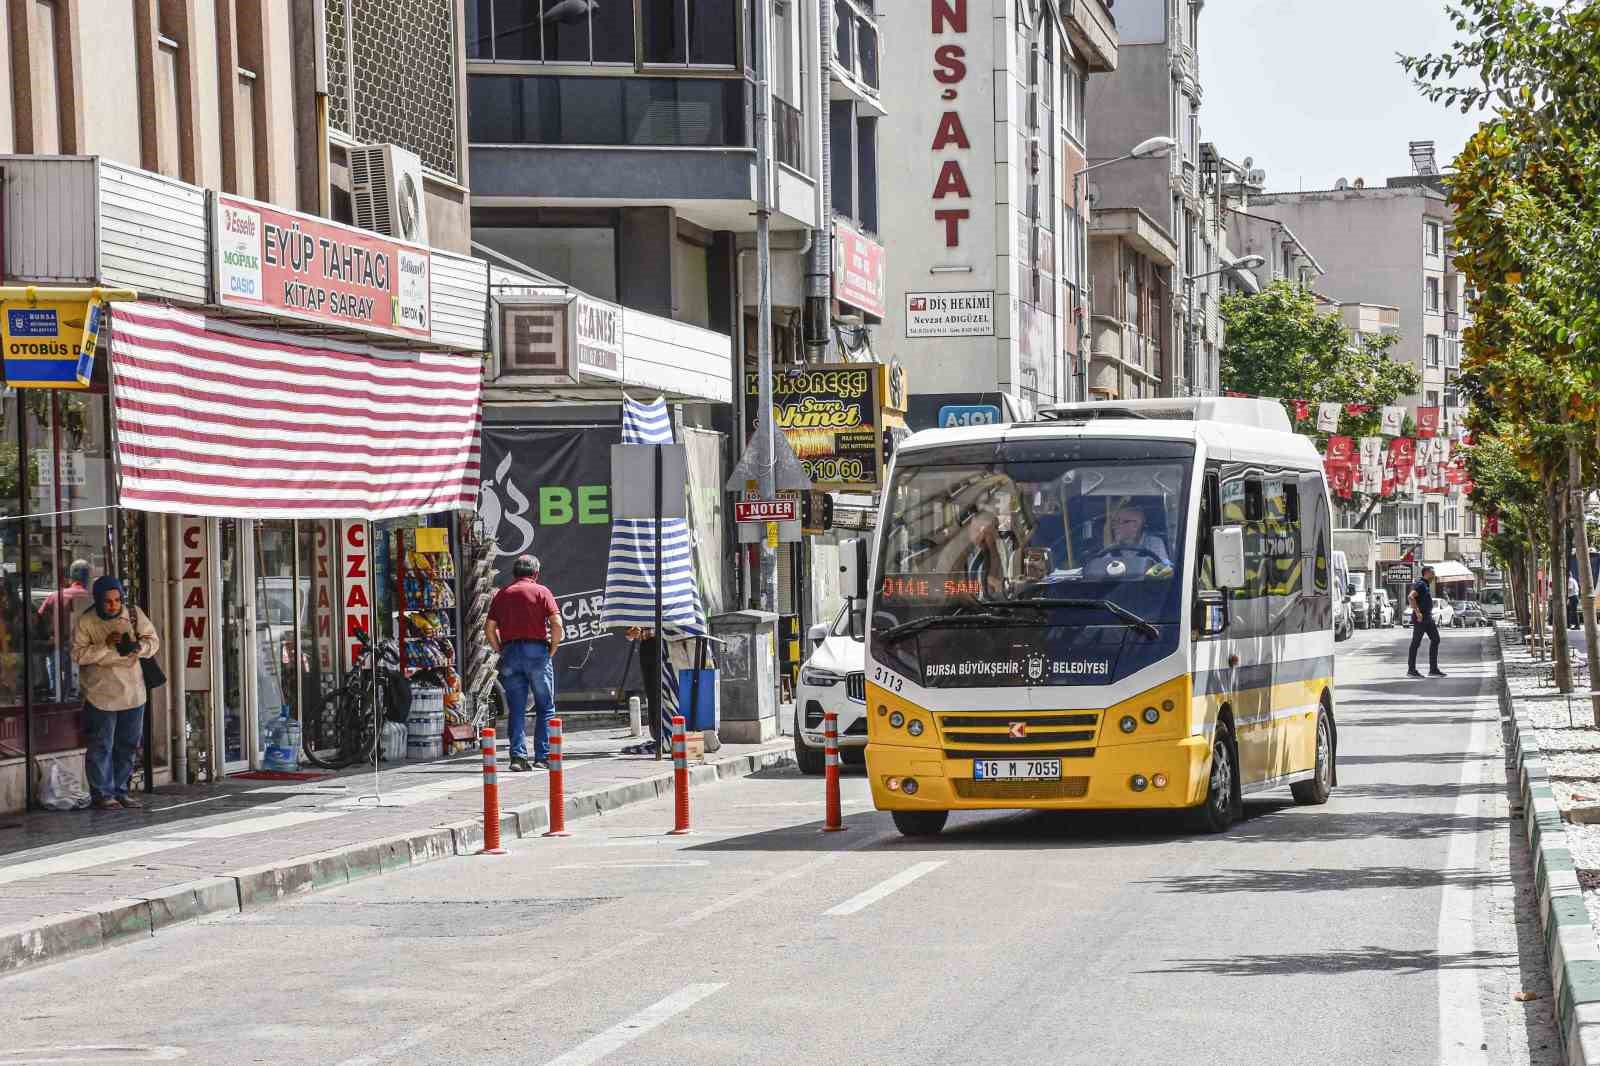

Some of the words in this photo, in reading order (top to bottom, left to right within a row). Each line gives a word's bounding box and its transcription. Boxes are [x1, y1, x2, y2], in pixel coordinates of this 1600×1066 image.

[264, 222, 314, 273] EYÜP
[319, 239, 390, 290] TAHTACI
[230, 276, 255, 294] CASIO
[284, 279, 326, 311] KİTAP
[330, 292, 374, 319] SARAY
[930, 297, 948, 312] DİŞ
[951, 294, 990, 310] HEKİMİ
[914, 315, 942, 324] Nevzat
[945, 313, 988, 324] ADIGÜZEL
[10, 341, 68, 355] OTOBÜS
[515, 315, 556, 364] E
[746, 372, 868, 397] KKOREÇÇİ
[816, 460, 837, 478] 10
[839, 460, 863, 478] 60
[540, 485, 609, 525] BE
[183, 515, 206, 669] CZANE
[926, 664, 956, 676] BURSA
[959, 659, 1019, 677] BÜYÜKŞEHİR
[1053, 659, 1108, 674] BELEDİYESİ
[874, 667, 903, 692] 3113
[984, 762, 998, 776] 16
[1009, 762, 1017, 776] M
[1028, 762, 1058, 776] 7055
